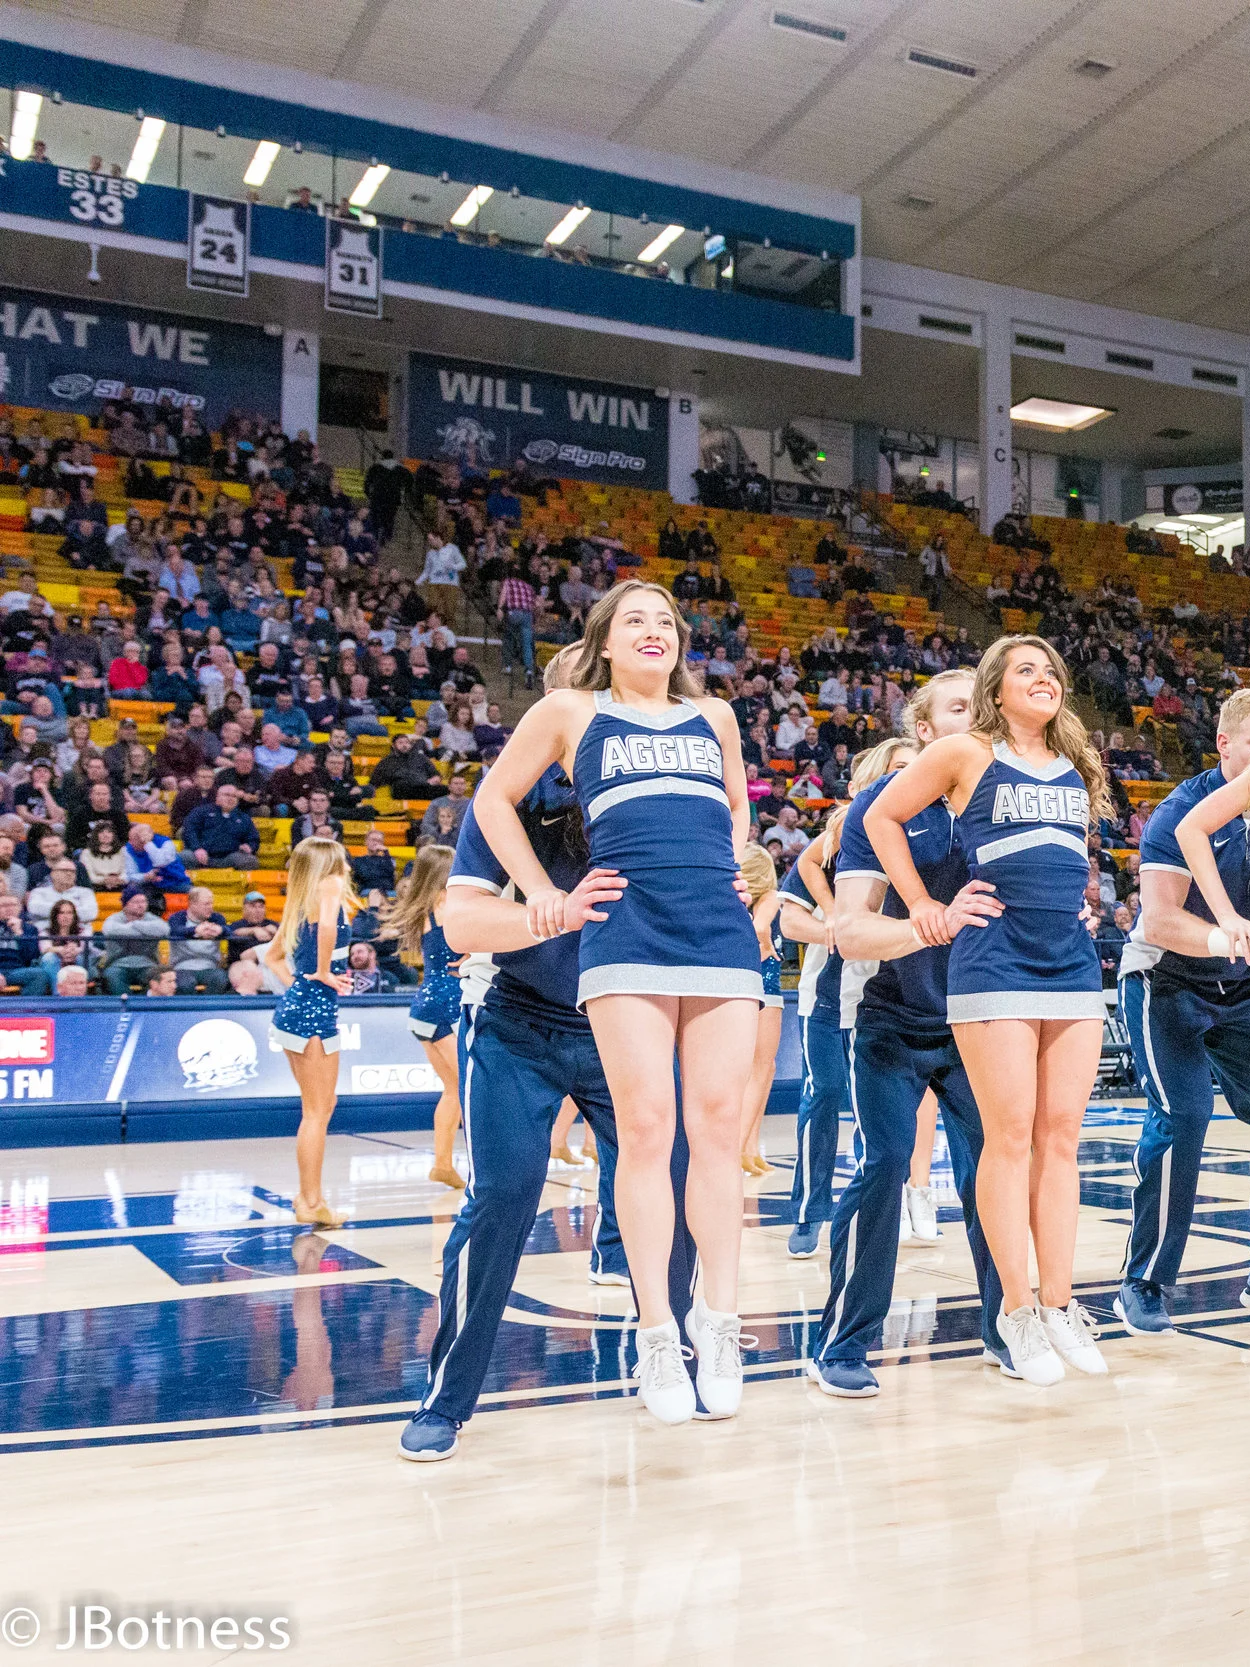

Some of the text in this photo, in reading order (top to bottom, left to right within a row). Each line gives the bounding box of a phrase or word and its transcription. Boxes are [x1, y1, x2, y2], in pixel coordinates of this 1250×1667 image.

[57, 167, 139, 199] ESTES
[69, 189, 124, 226] 33
[200, 238, 237, 264] 24
[339, 263, 368, 286] 31
[127, 320, 210, 366] WE
[294, 338, 310, 355] A
[437, 370, 650, 431] WILL WIN
[679, 399, 692, 414] B
[994, 447, 1006, 463] C
[600, 734, 723, 780] AGGIES
[13, 1068, 54, 1099] FM
[358, 1067, 440, 1090] CAC
